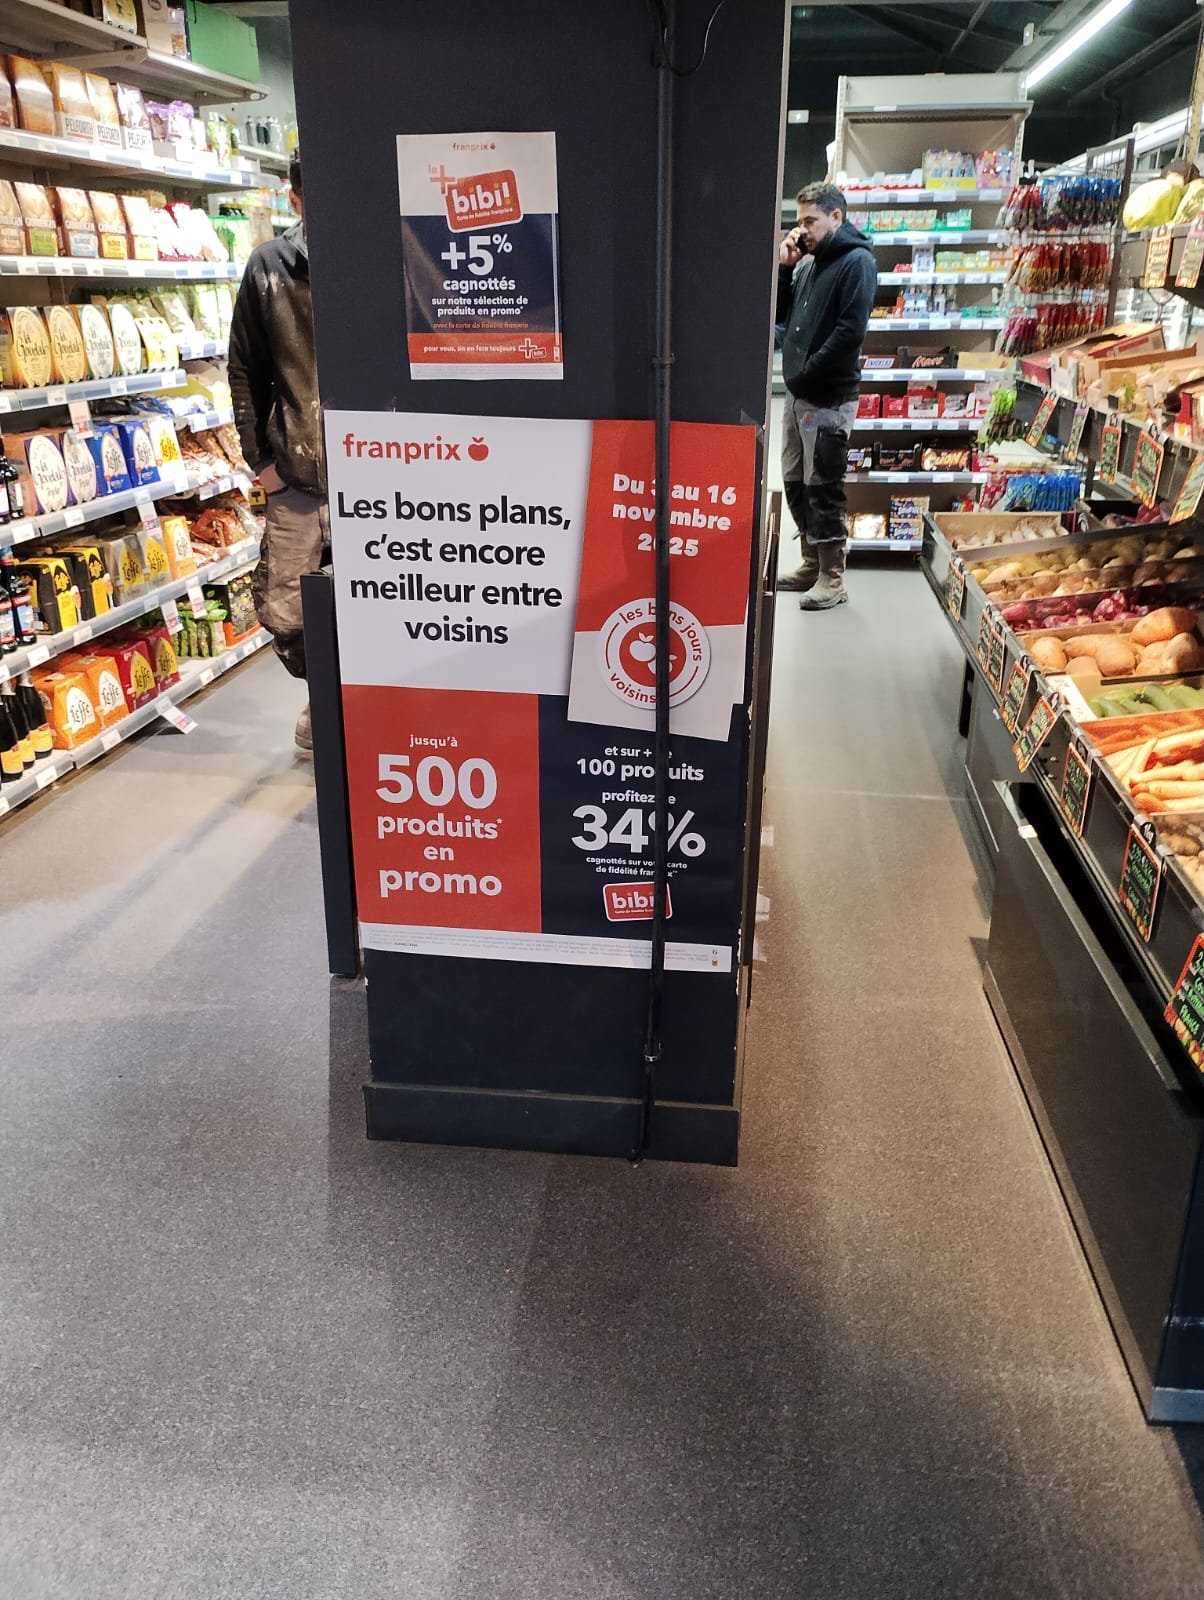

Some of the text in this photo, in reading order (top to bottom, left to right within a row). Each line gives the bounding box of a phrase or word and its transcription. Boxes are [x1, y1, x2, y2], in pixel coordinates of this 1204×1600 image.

[452, 142, 489, 152] franprix
[451, 181, 511, 214] bibi!
[441, 233, 513, 276] +5%
[443, 276, 516, 294] cagnottés
[431, 295, 528, 305] sur notre sélection de
[437, 306, 476, 318] produits
[477, 308, 489, 316] en
[343, 433, 461, 464] franprix
[613, 473, 645, 494] Du
[671, 484, 700, 501] au
[706, 485, 737, 505] 16
[337, 491, 571, 532] Les bons plans,
[612, 503, 731, 531] novmbre
[364, 534, 546, 566] c'est encore
[637, 533, 699, 557] 225
[350, 573, 563, 607] meilleur entre
[404, 615, 509, 645] voisins
[619, 602, 702, 661] les bns jours
[610, 673, 657, 704] voisins
[409, 734, 458, 749] jusqu'à
[604, 746, 618, 756] et
[620, 748, 641, 757] sur
[375, 753, 498, 810] 500
[576, 758, 705, 782] 100 prouits
[601, 789, 656, 804] profitez
[571, 804, 706, 857] 34%
[423, 845, 455, 861] en
[586, 856, 627, 866] cagnottés
[379, 869, 502, 898] promo
[608, 865, 638, 875] fidélité
